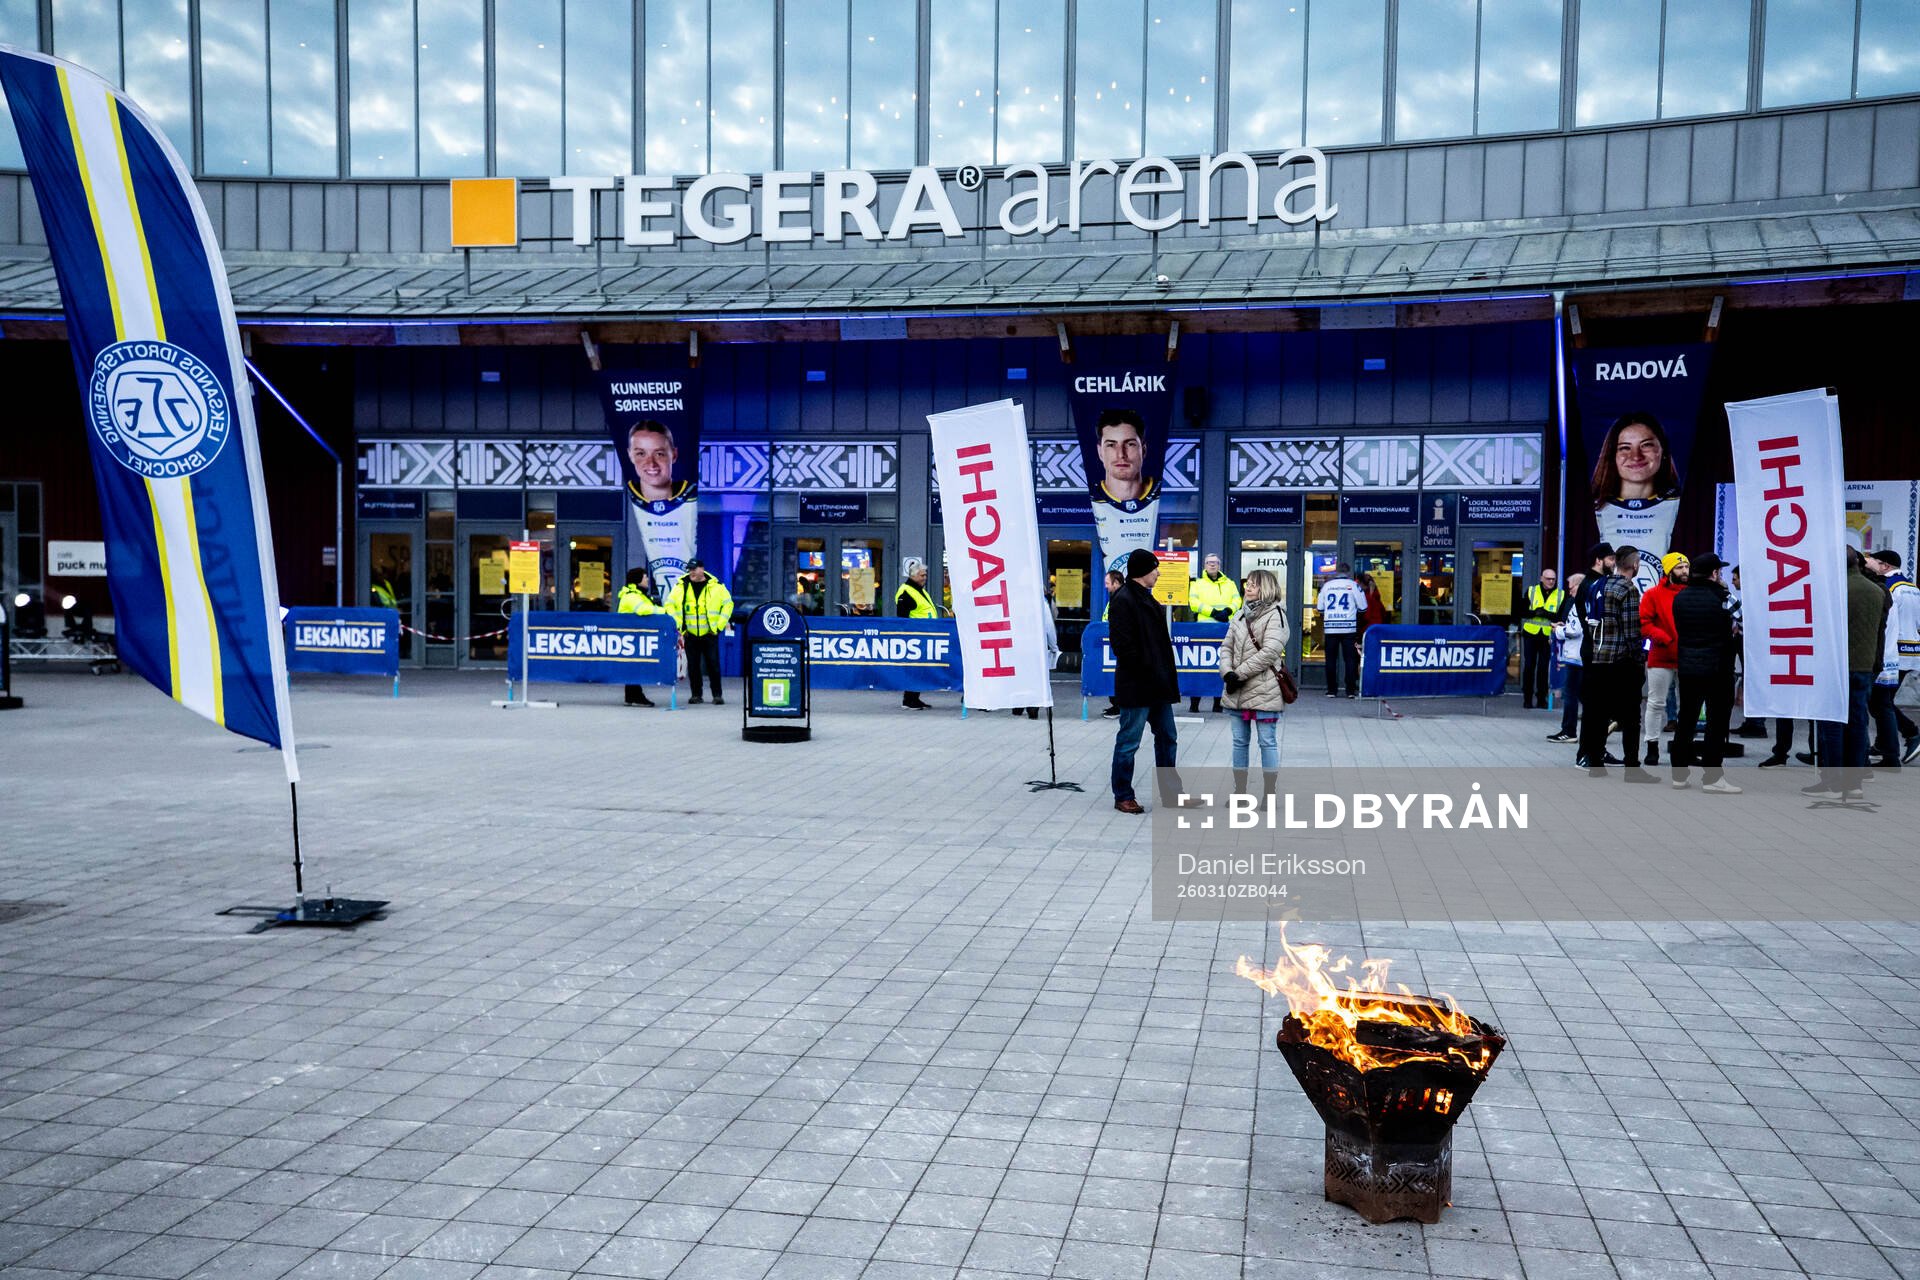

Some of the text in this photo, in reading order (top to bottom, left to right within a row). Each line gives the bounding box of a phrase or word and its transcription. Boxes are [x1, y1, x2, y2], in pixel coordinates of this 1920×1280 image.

[999, 147, 1339, 236] arena
[1596, 354, 1688, 381] RADOVÁ
[610, 382, 682, 395] KUNNERUP
[1074, 371, 1167, 393] CEHLÁRIK
[614, 399, 684, 413] SØRENSEN
[1426, 525, 1450, 537] Biljett
[1423, 536, 1453, 546] Service
[57, 561, 85, 572] puck
[1257, 558, 1288, 567] HITA
[1327, 593, 1350, 610] 24
[295, 626, 386, 648] LEKSANDS IF
[638, 635, 659, 657] IF
[804, 637, 950, 661] EKSANDS IF
[1380, 646, 1495, 667] LEKSANDS IF
